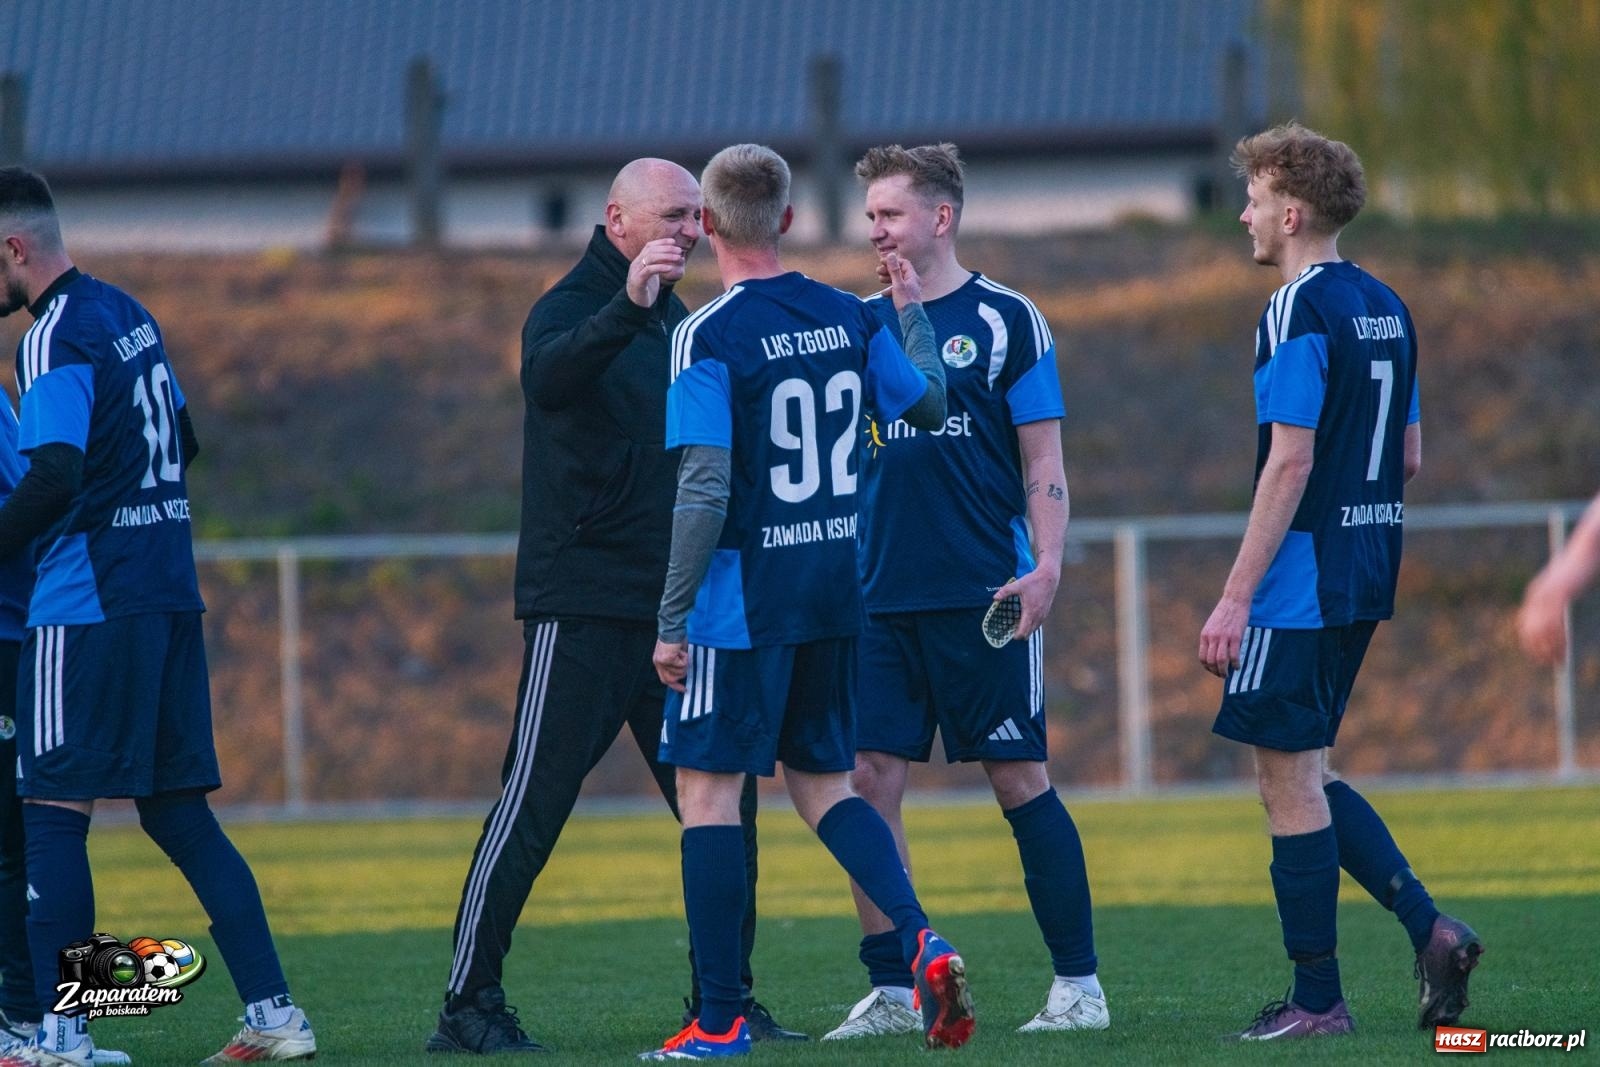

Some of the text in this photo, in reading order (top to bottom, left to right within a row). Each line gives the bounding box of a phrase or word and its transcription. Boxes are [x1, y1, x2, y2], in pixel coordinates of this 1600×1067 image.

[761, 325, 851, 361] LKS ZGODA
[1367, 315, 1404, 340] GODA
[133, 362, 181, 489] 10
[770, 370, 862, 503] 92
[1366, 360, 1394, 481] 7
[762, 520, 823, 548] ZAWADA
